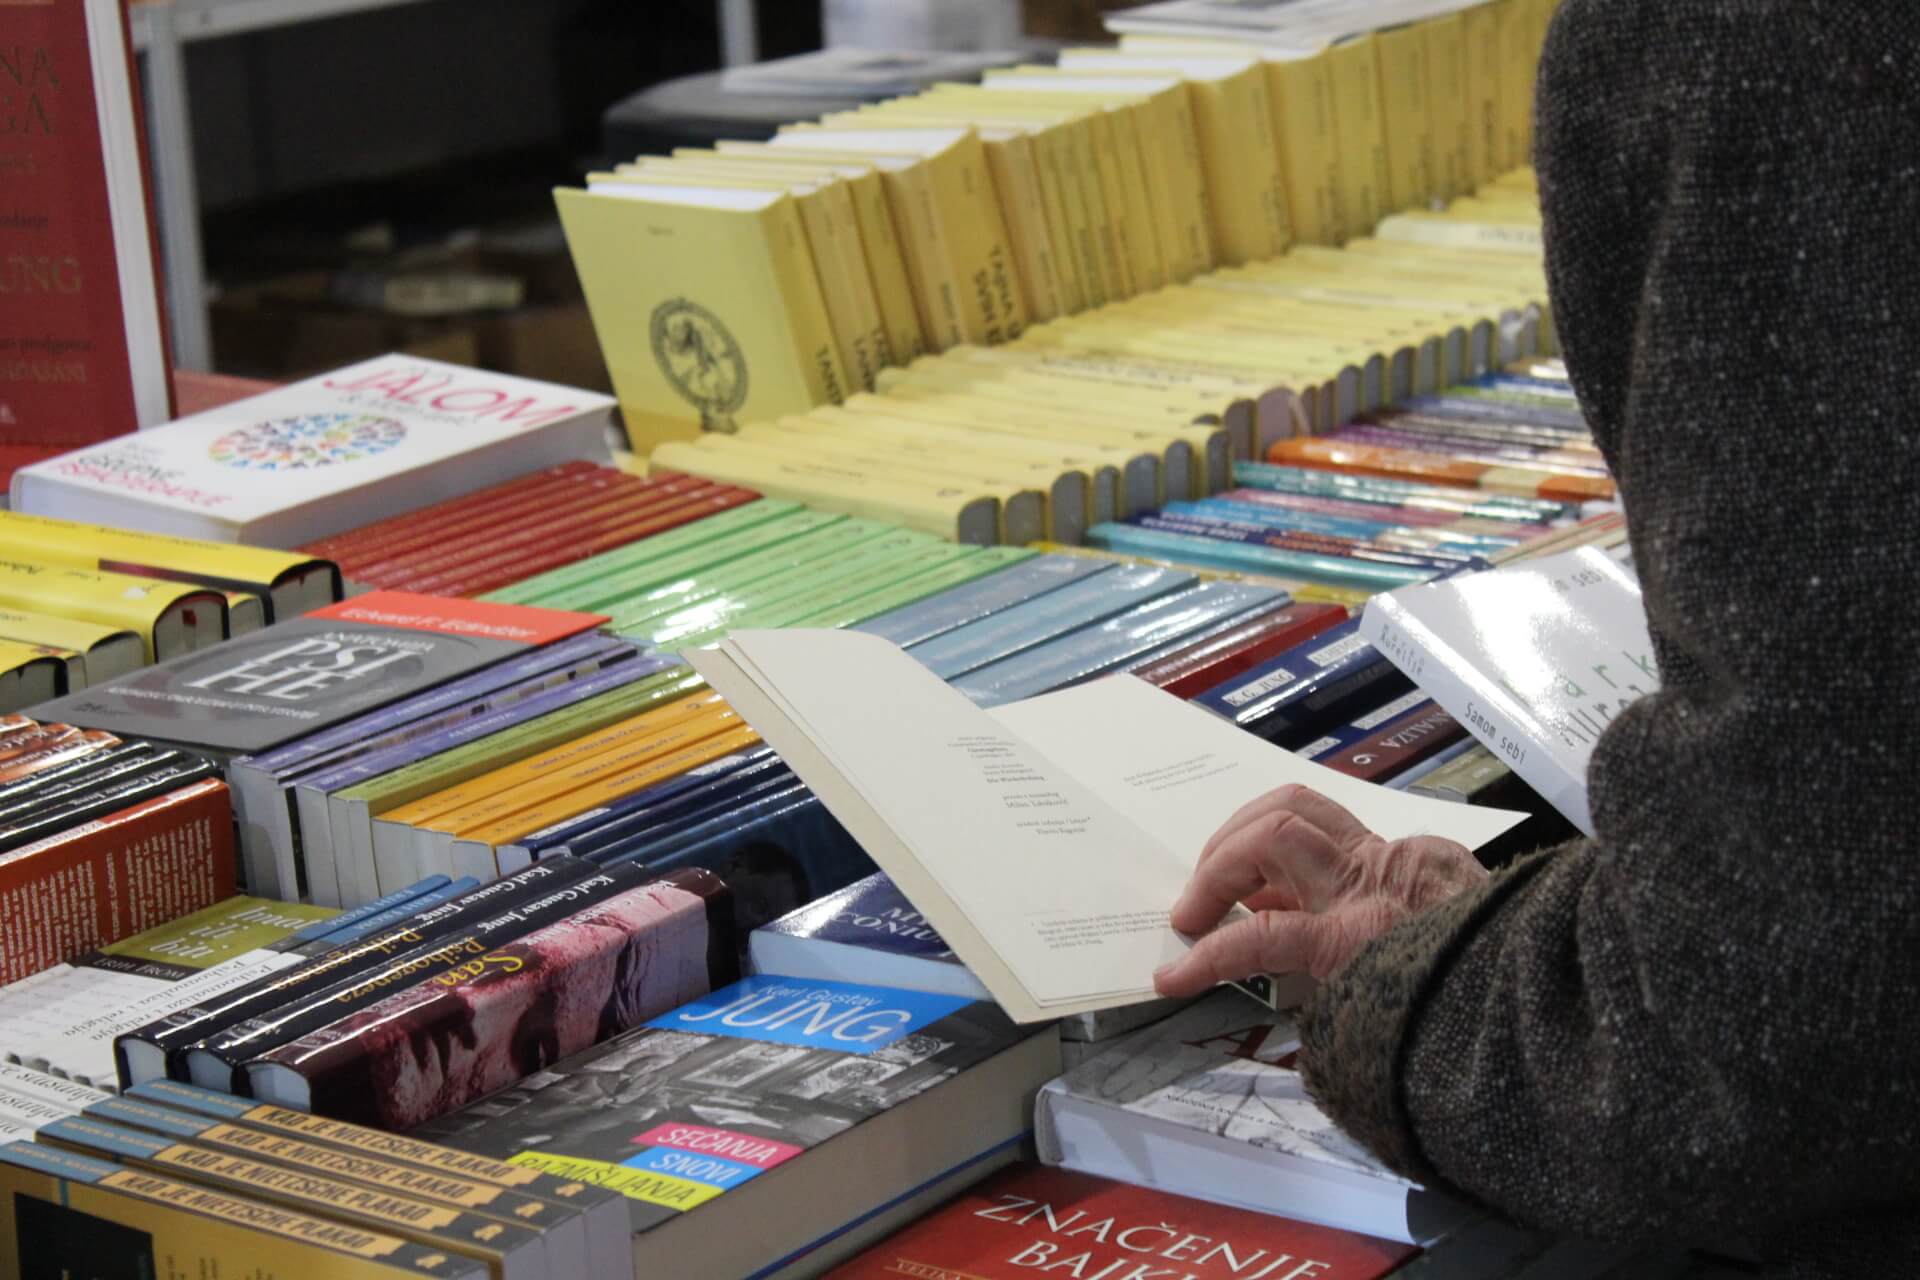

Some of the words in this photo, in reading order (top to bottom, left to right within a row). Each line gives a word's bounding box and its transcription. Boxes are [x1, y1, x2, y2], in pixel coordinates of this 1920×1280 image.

[322, 370, 577, 427] JALOM
[250, 636, 423, 679] PSI
[1380, 632, 1424, 677] Aurelije
[186, 661, 366, 700] HE
[1260, 672, 1289, 693] JUNG
[1464, 702, 1497, 740] Samom
[1499, 736, 1527, 765] sebi
[104, 852, 117, 896] LIČNOSTI
[515, 865, 554, 891] Karl
[577, 874, 616, 898] Karl
[415, 899, 463, 923] Jung
[465, 882, 514, 907] Gustav
[524, 889, 577, 918] Gustav
[108, 898, 121, 938] TEORIJE
[190, 921, 249, 939] ili
[228, 905, 322, 929] Imat
[476, 906, 527, 934] Jung
[836, 911, 943, 943] CONIU
[150, 937, 229, 959] biti
[269, 926, 425, 992] Psihogeneza
[94, 957, 136, 970] ERIH
[136, 963, 186, 979] FROM
[140, 960, 246, 1006] Psihoanaliza
[165, 964, 273, 1010] Psihoanaliza
[335, 935, 487, 1004] Psihogeneza
[434, 949, 525, 987] San
[762, 984, 803, 999] Karl
[805, 988, 882, 1008] Gustav
[64, 1008, 124, 1038] religija
[91, 1012, 151, 1042] religija
[679, 993, 912, 1044] JUNG
[303, 1116, 332, 1134] JE
[332, 1122, 435, 1161] NIETZSCHE
[439, 1147, 516, 1179] PLAKAO
[657, 1127, 779, 1163] SEĆANJA
[262, 1137, 290, 1154] JE
[289, 1141, 391, 1180] NIETZSCHE
[395, 1168, 474, 1200] PLAKAO
[650, 1152, 742, 1183] SNOVI
[214, 1158, 247, 1177] JE
[248, 1163, 352, 1204] NIETZSCHE
[356, 1191, 434, 1222] PLAKAO
[158, 1184, 188, 1201] JE
[188, 1191, 290, 1232] NIETZSCHE
[292, 1214, 375, 1250] PLAKAO
[973, 1194, 1332, 1280] ZNAČENJE
